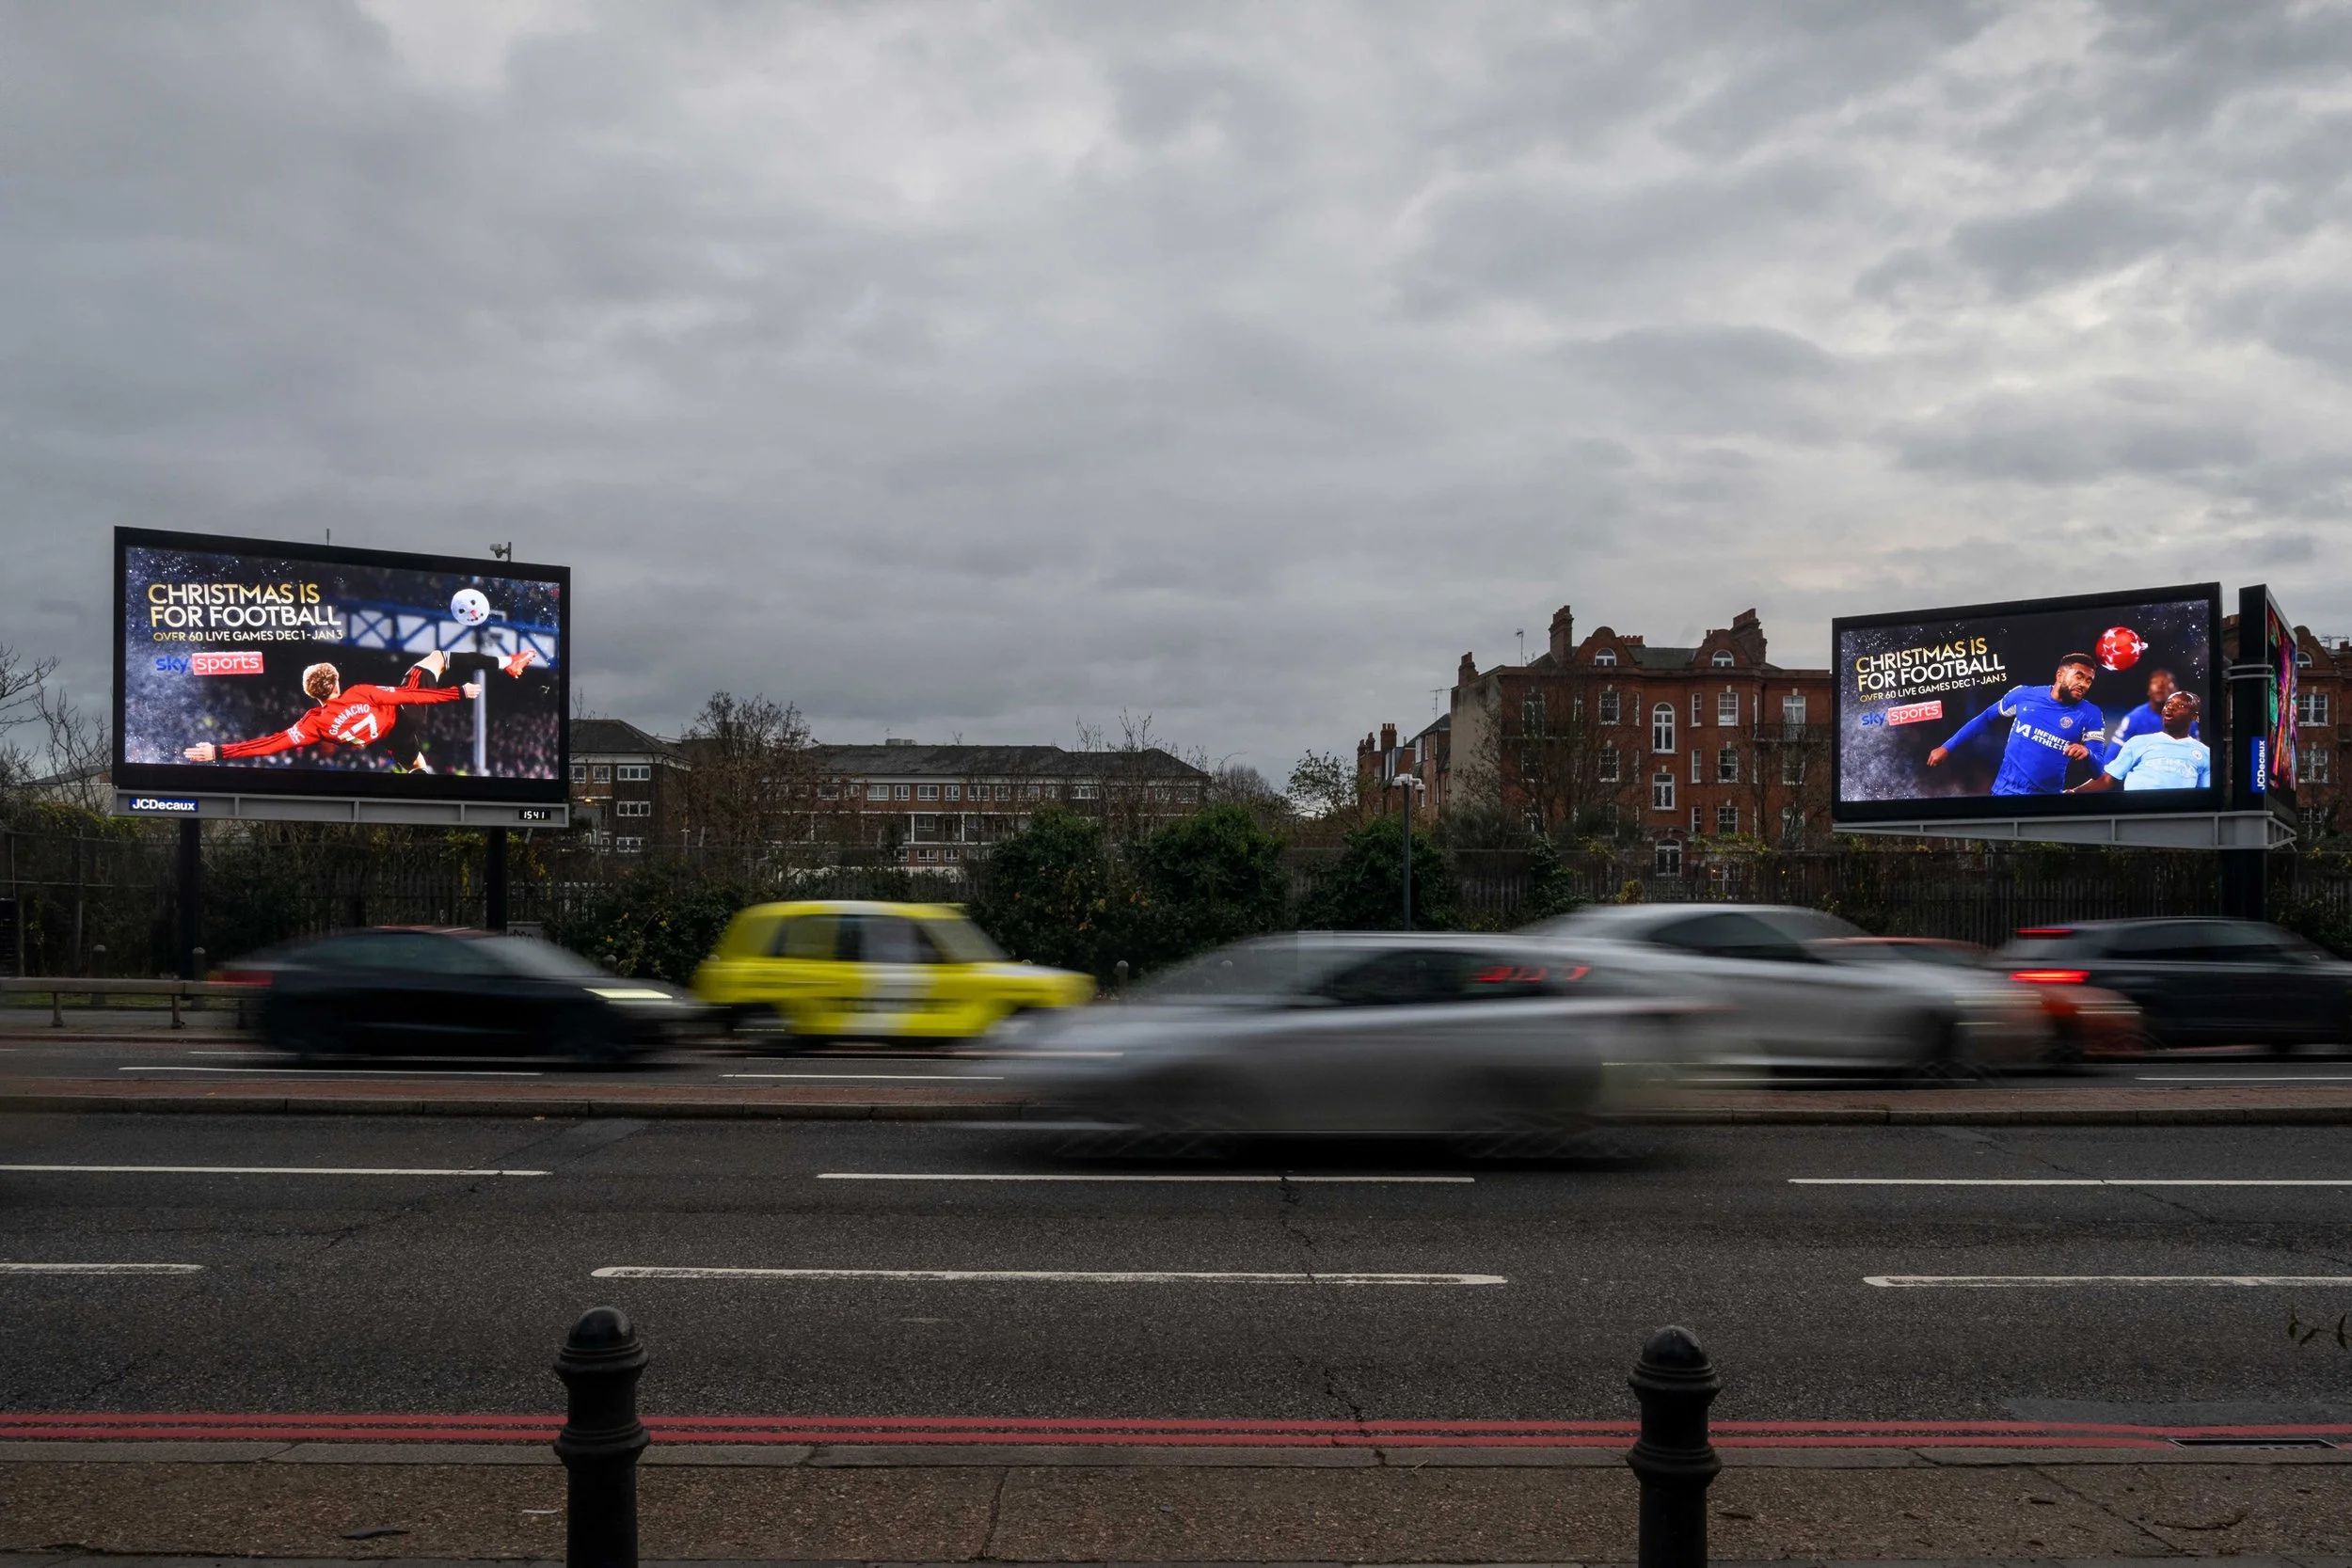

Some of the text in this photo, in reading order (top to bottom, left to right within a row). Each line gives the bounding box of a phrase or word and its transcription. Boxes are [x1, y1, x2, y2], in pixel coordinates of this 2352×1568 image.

[148, 583, 321, 605] CHRISTMAS IS
[151, 605, 342, 628] FOR FOOTBALL
[153, 631, 186, 641] OVER
[189, 631, 203, 641] 60
[206, 631, 230, 641] LIVE
[232, 630, 274, 641] GAMES
[155, 655, 260, 674] sky sports
[1855, 637, 1988, 674] CHRISTMAS IS
[1858, 653, 2006, 692] FOR FOOTBALL
[1859, 692, 1883, 703] OVER
[1885, 690, 1897, 700] 60
[1898, 687, 1917, 697] LIVE
[1918, 682, 1950, 695] GAMES
[328, 704, 371, 736] GARNACHO
[1861, 705, 1940, 726] sky sports
[337, 712, 379, 746] 17
[2257, 740, 2265, 790] JCDecaux
[132, 798, 197, 811] JCDecaux
